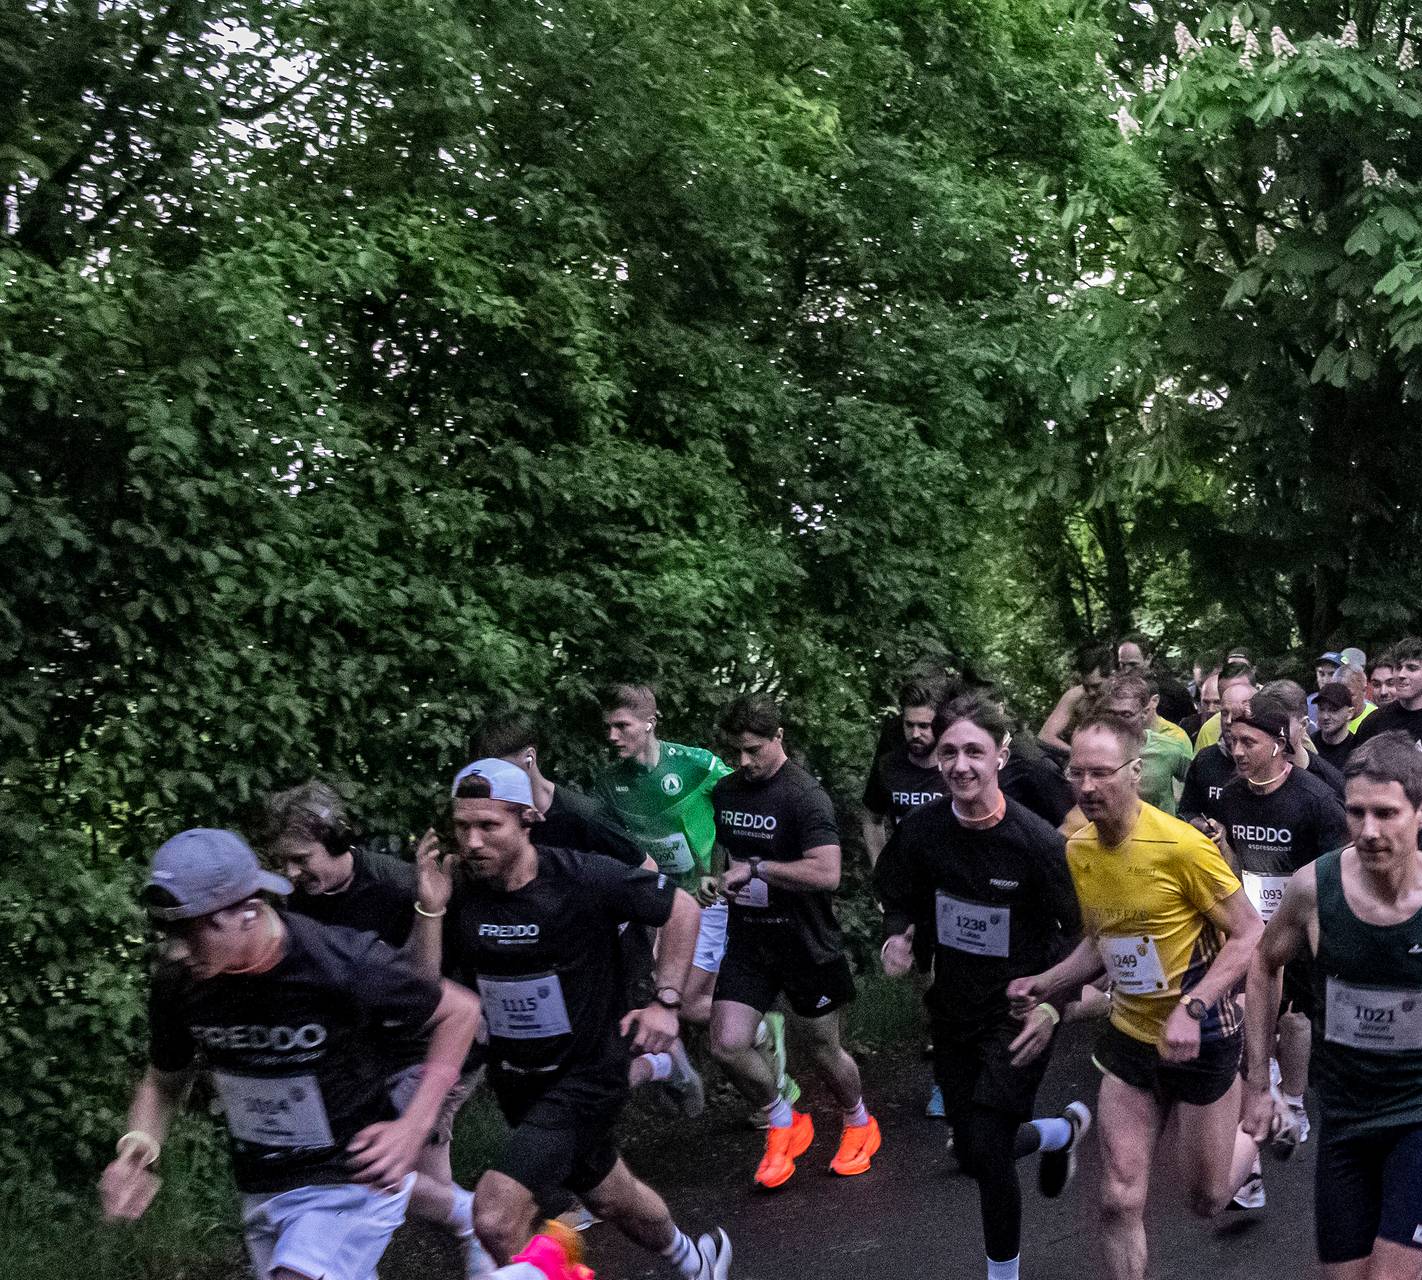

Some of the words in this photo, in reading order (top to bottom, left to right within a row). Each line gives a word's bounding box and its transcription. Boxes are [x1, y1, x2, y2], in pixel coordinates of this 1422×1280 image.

[721, 810, 777, 830] FREDDO
[1232, 824, 1291, 843] FREDDO
[479, 924, 540, 937] FREDDO
[956, 915, 987, 932] 1238
[500, 997, 537, 1012] 1115
[1353, 1005, 1395, 1023] 1021
[190, 1023, 328, 1050] FREDDO
